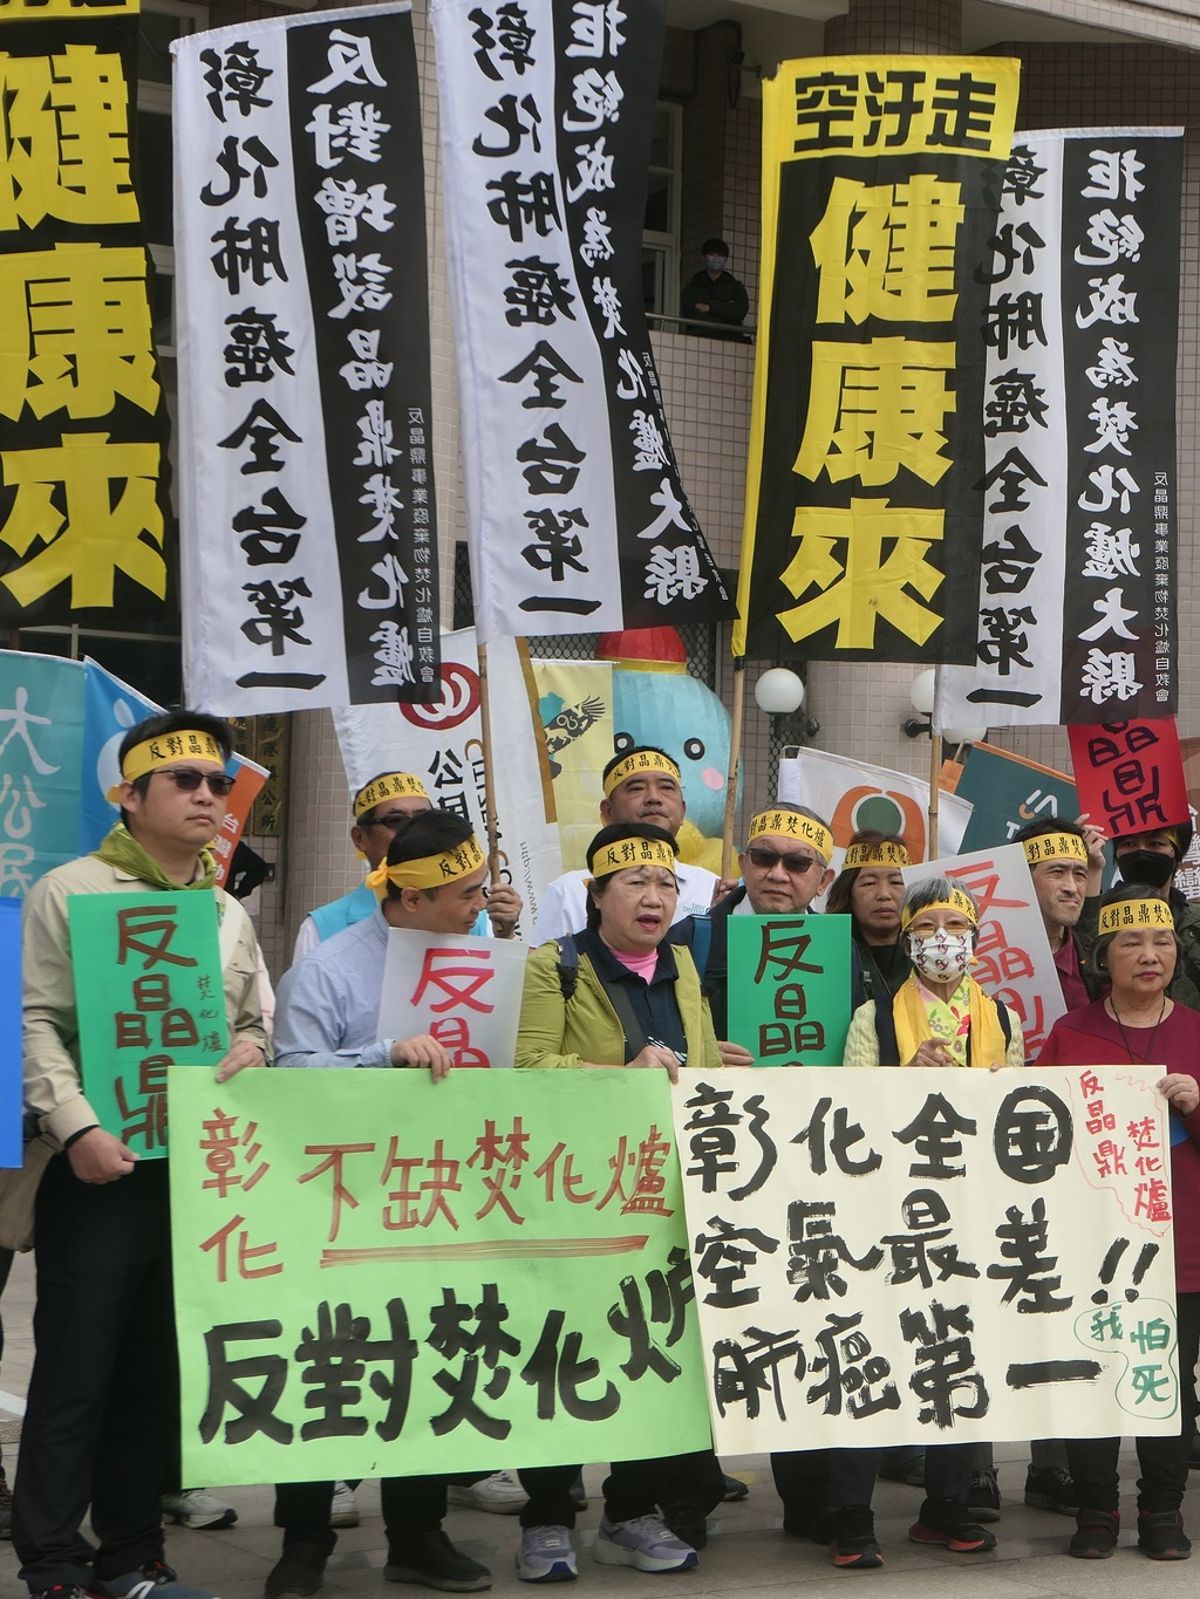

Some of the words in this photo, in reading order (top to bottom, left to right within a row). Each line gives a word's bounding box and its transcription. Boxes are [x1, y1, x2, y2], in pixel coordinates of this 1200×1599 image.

[775, 173, 966, 650] 健康來
[752, 919, 826, 1066] 反晶
[199, 1107, 284, 1283] 彰化
[296, 1115, 676, 1243] 不缺焚化爐
